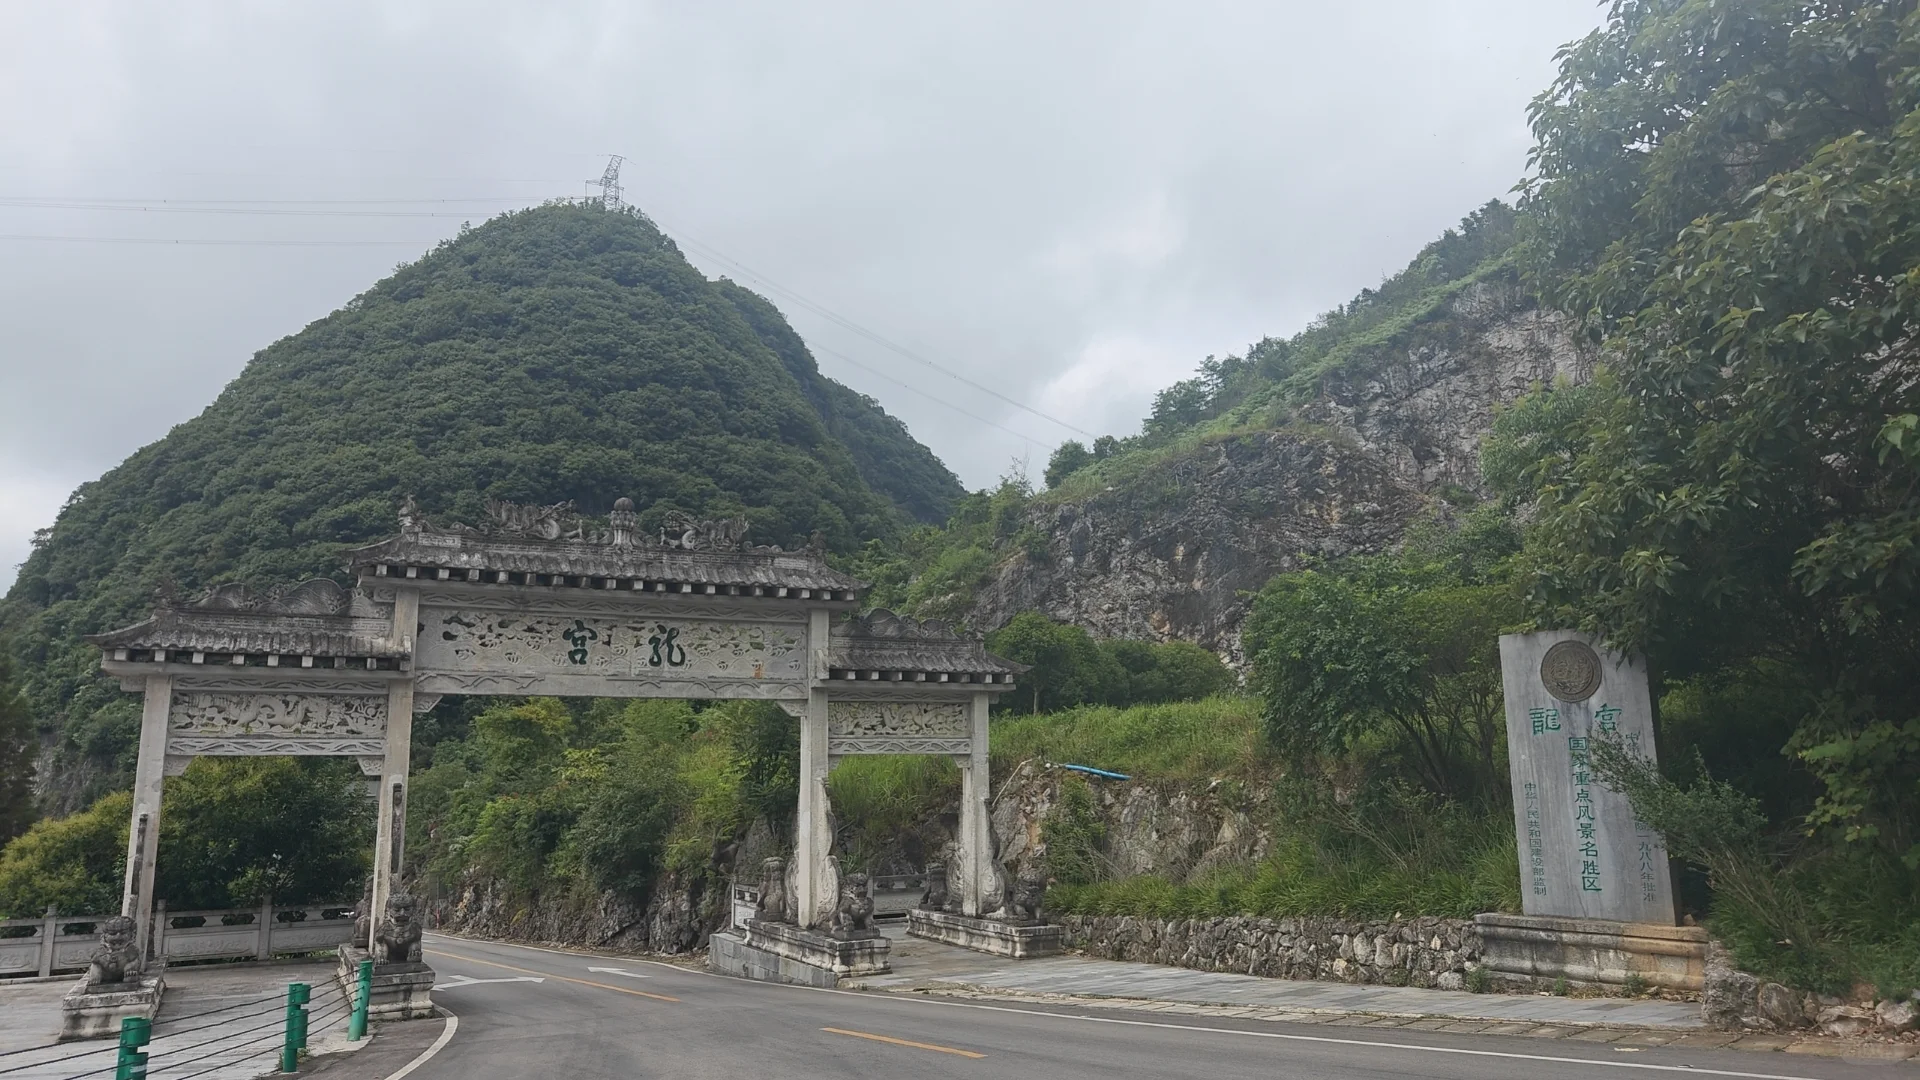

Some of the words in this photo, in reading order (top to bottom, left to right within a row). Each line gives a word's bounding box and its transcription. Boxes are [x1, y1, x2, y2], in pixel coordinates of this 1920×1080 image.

[1524, 782, 1547, 896] 中华人民共和国建设部监制
[1568, 736, 1602, 892] 国家重点风景名胜区
